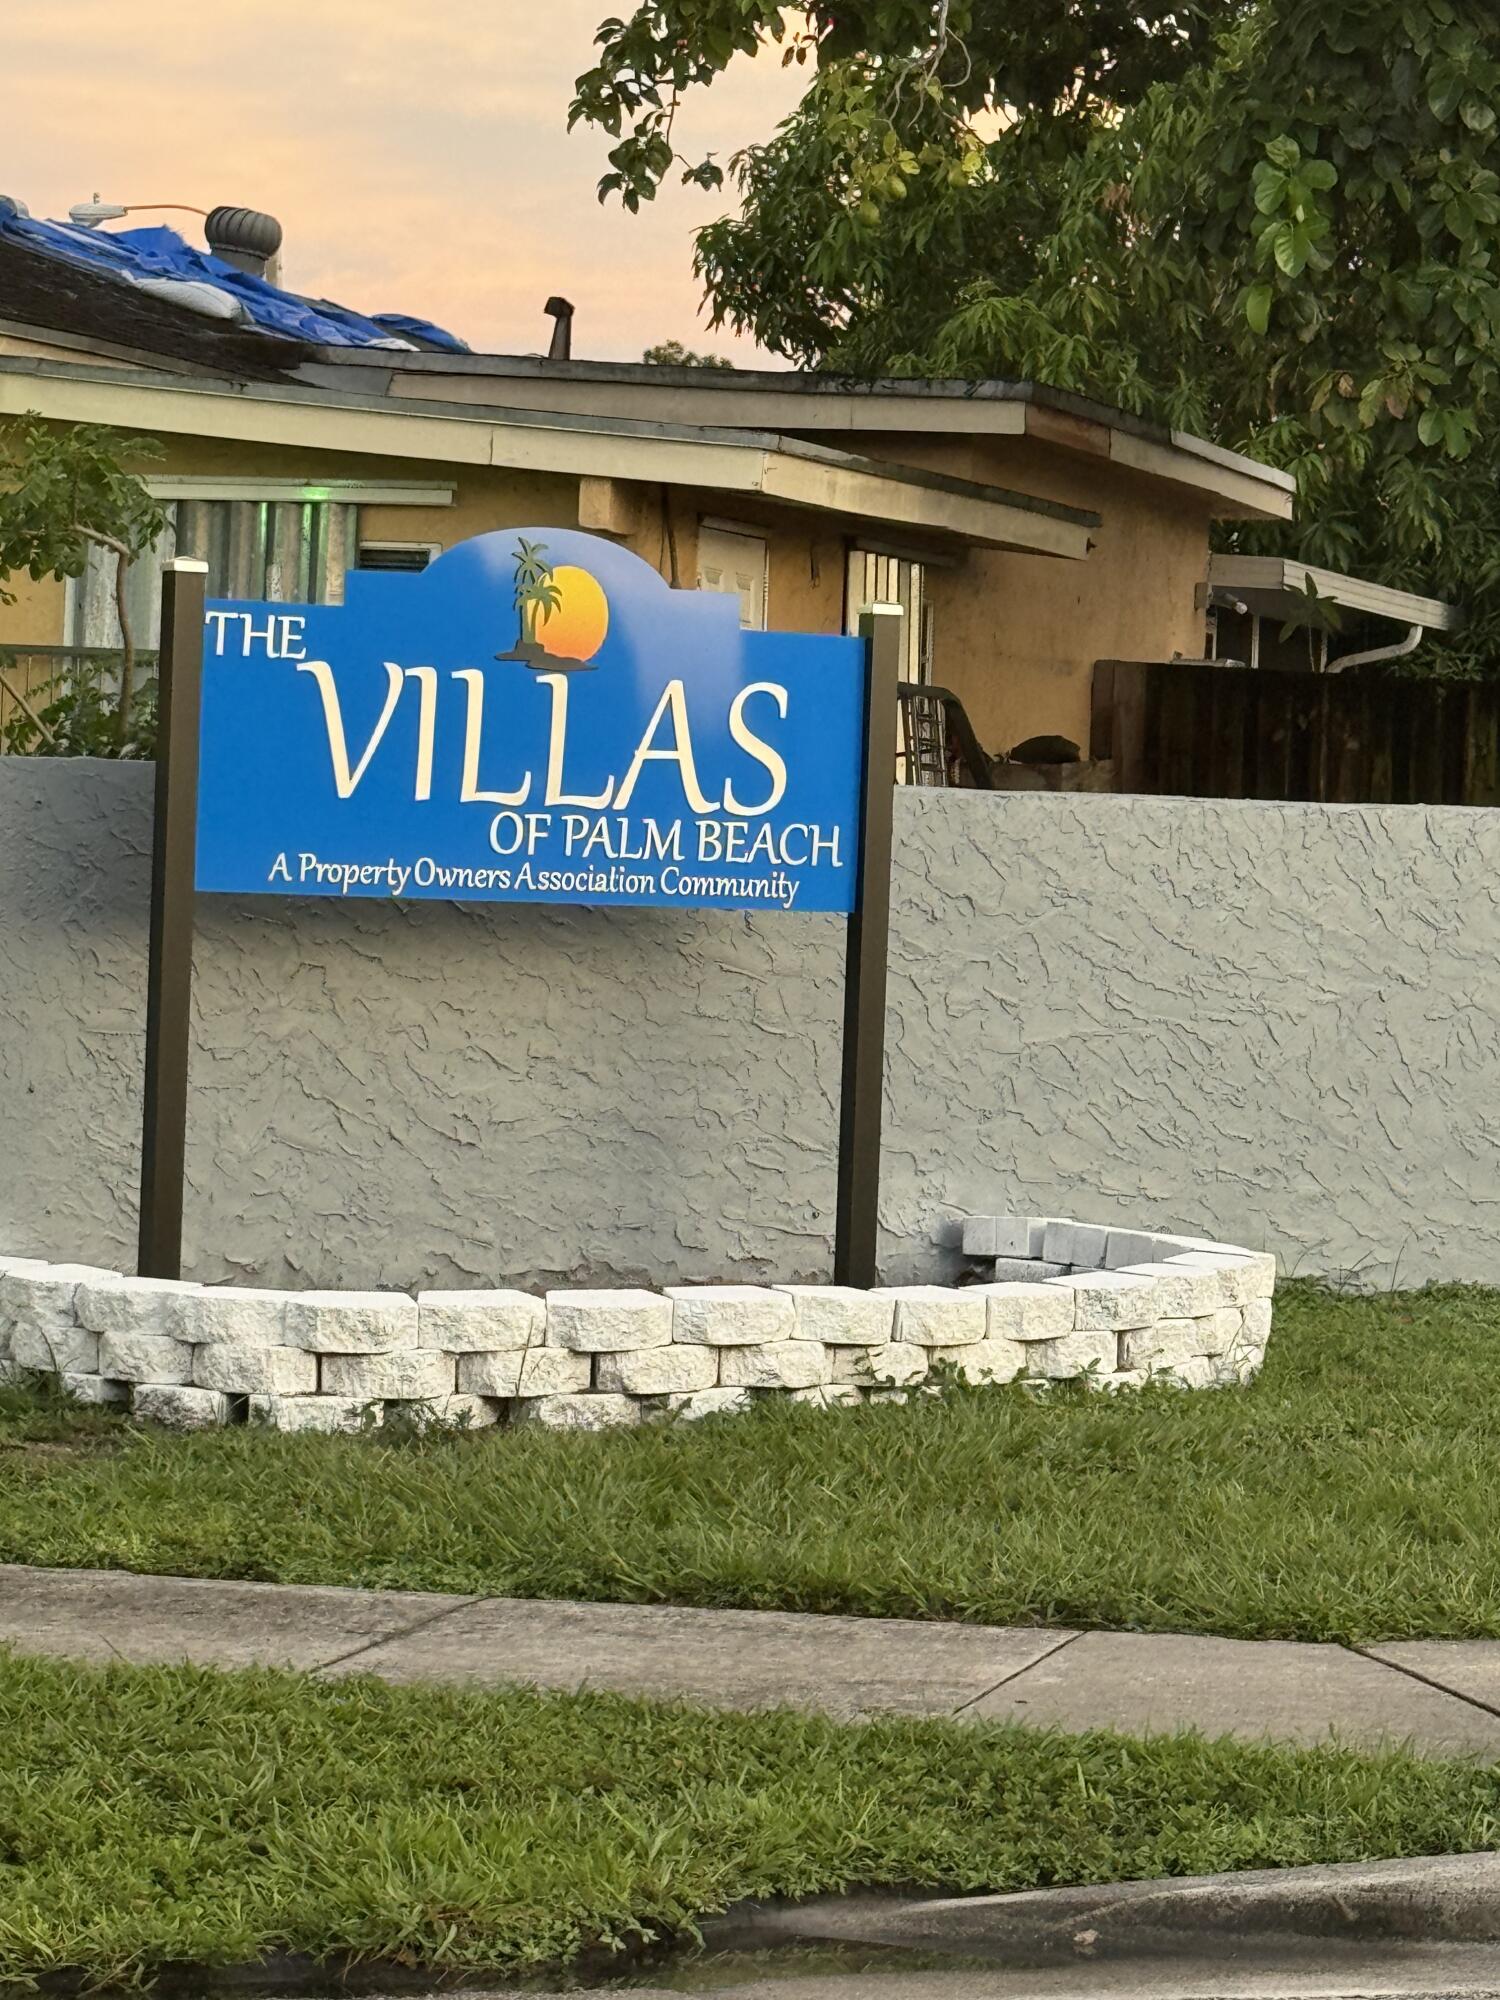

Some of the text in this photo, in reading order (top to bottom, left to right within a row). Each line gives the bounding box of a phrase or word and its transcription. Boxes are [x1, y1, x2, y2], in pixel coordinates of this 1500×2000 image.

[205, 611, 306, 660] THE
[297, 661, 788, 817] VILLAS
[489, 811, 843, 867] OF PALM BEACH
[268, 853, 800, 909] A Property Owners Association Community
